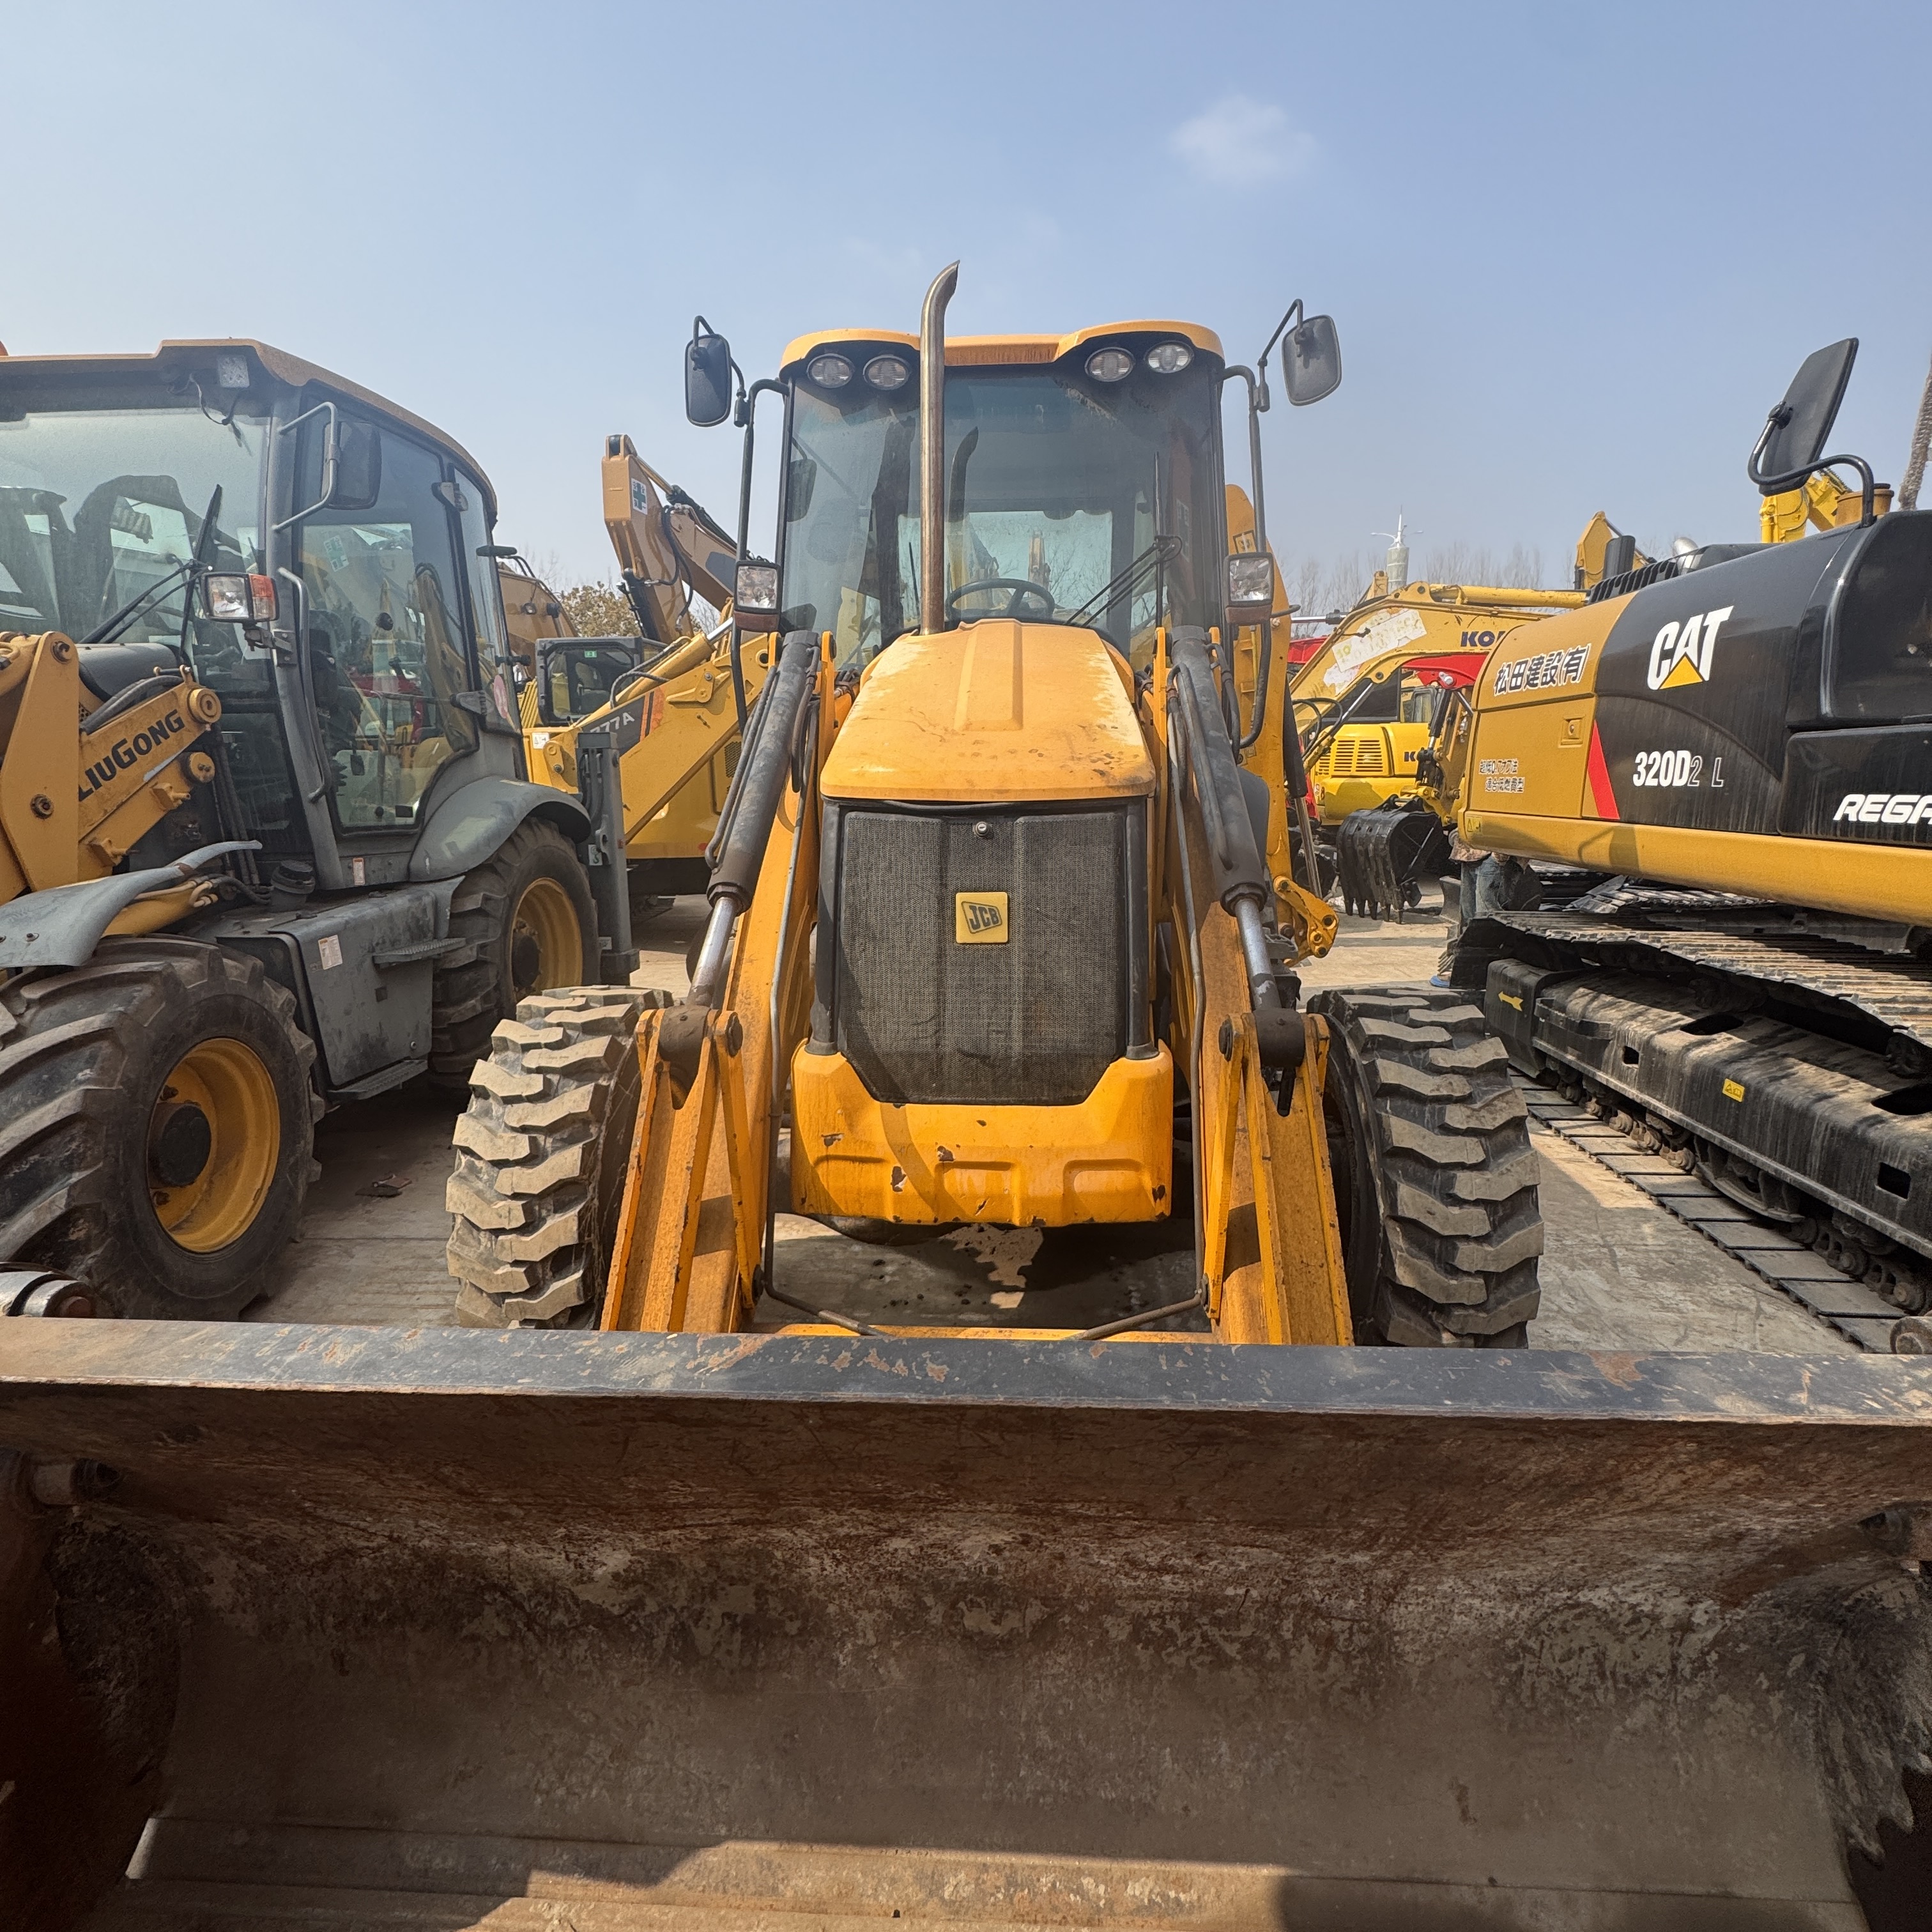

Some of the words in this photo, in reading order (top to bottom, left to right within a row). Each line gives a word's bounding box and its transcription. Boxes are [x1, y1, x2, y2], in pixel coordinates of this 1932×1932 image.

[1648, 606, 1734, 690] CAT
[1494, 643, 1591, 696] 松田建設(有)
[1711, 757, 1724, 787] L
[969, 905, 999, 930] JCB
